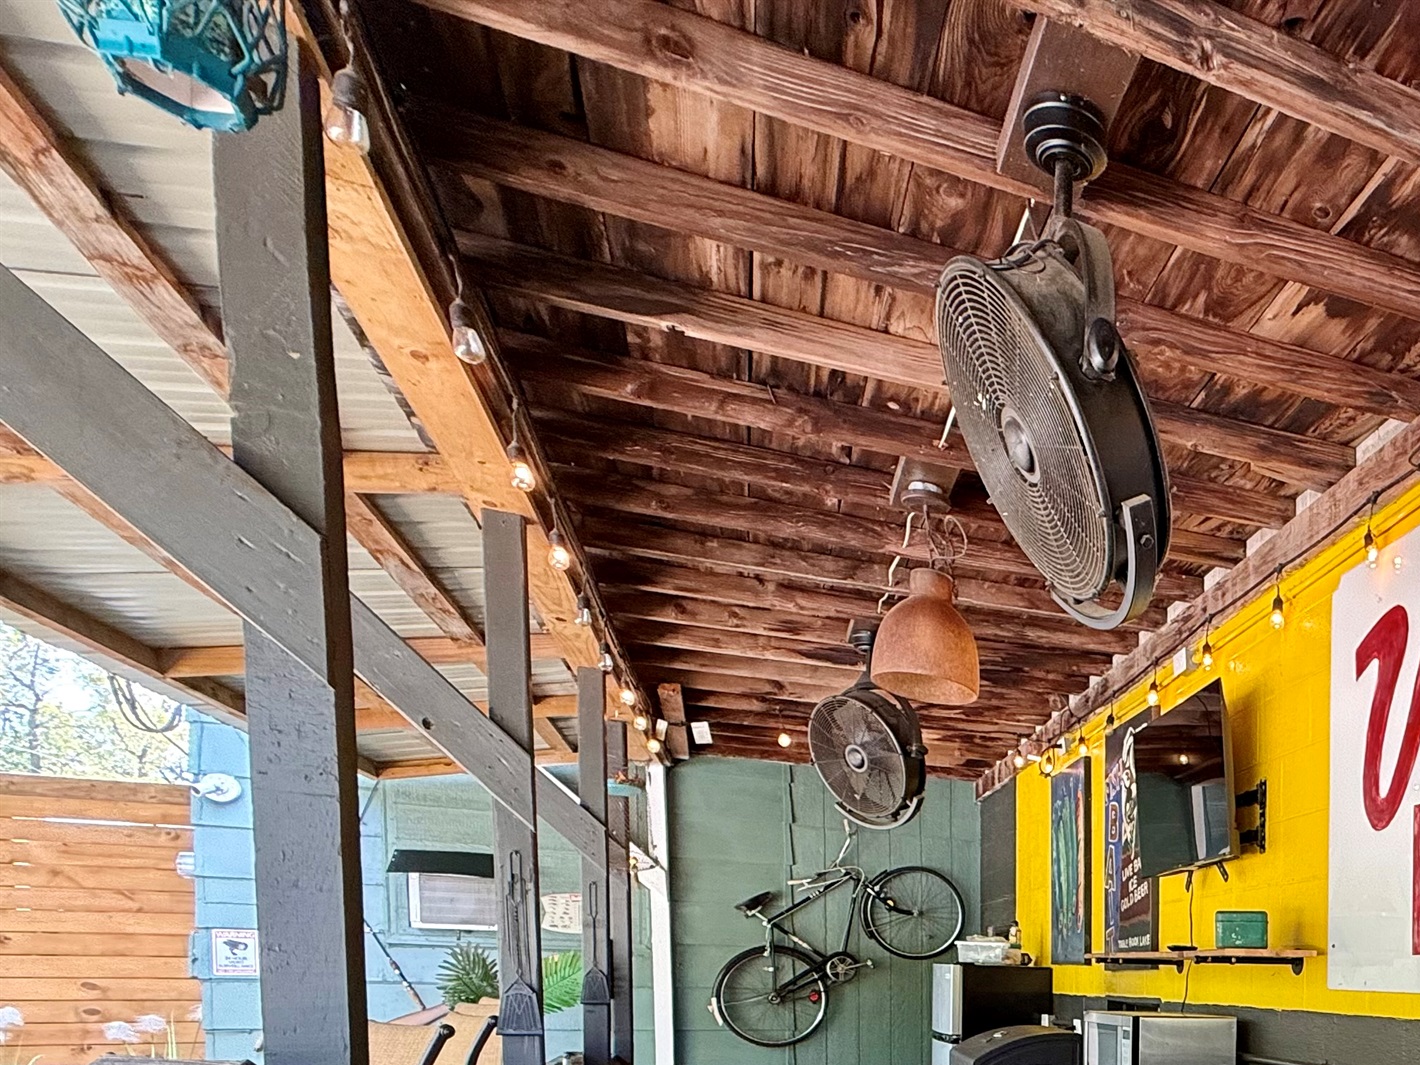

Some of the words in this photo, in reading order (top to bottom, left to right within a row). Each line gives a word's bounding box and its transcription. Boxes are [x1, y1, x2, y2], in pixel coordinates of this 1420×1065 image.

[1122, 862, 1133, 882] LIVE
[1133, 857, 1142, 874] BA
[1128, 875, 1138, 892] ICE
[1134, 881, 1149, 903] BEER
[1140, 934, 1150, 947] LAKE
